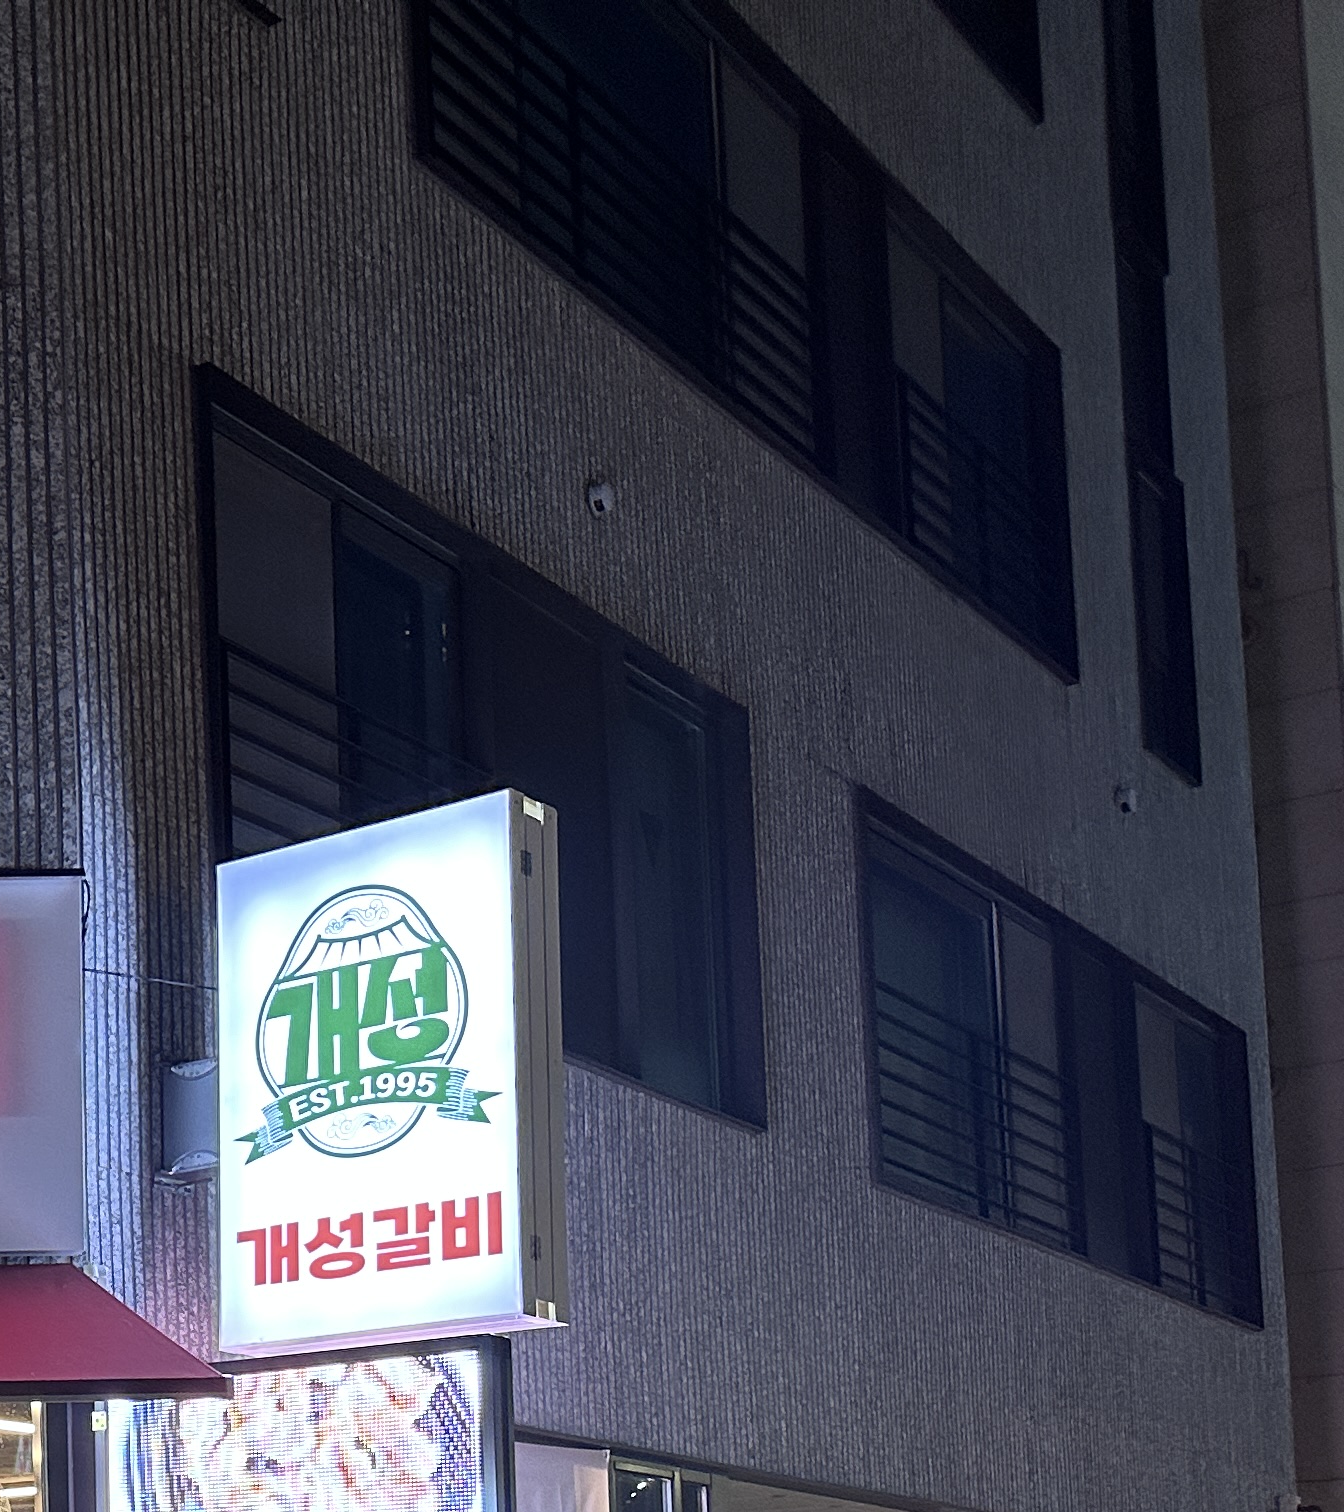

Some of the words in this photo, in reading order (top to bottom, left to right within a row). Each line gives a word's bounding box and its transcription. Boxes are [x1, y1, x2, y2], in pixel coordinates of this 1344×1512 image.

[267, 941, 451, 1088] 개성
[289, 1070, 438, 1124] EST.1995
[237, 1191, 504, 1286] 개성갈비
